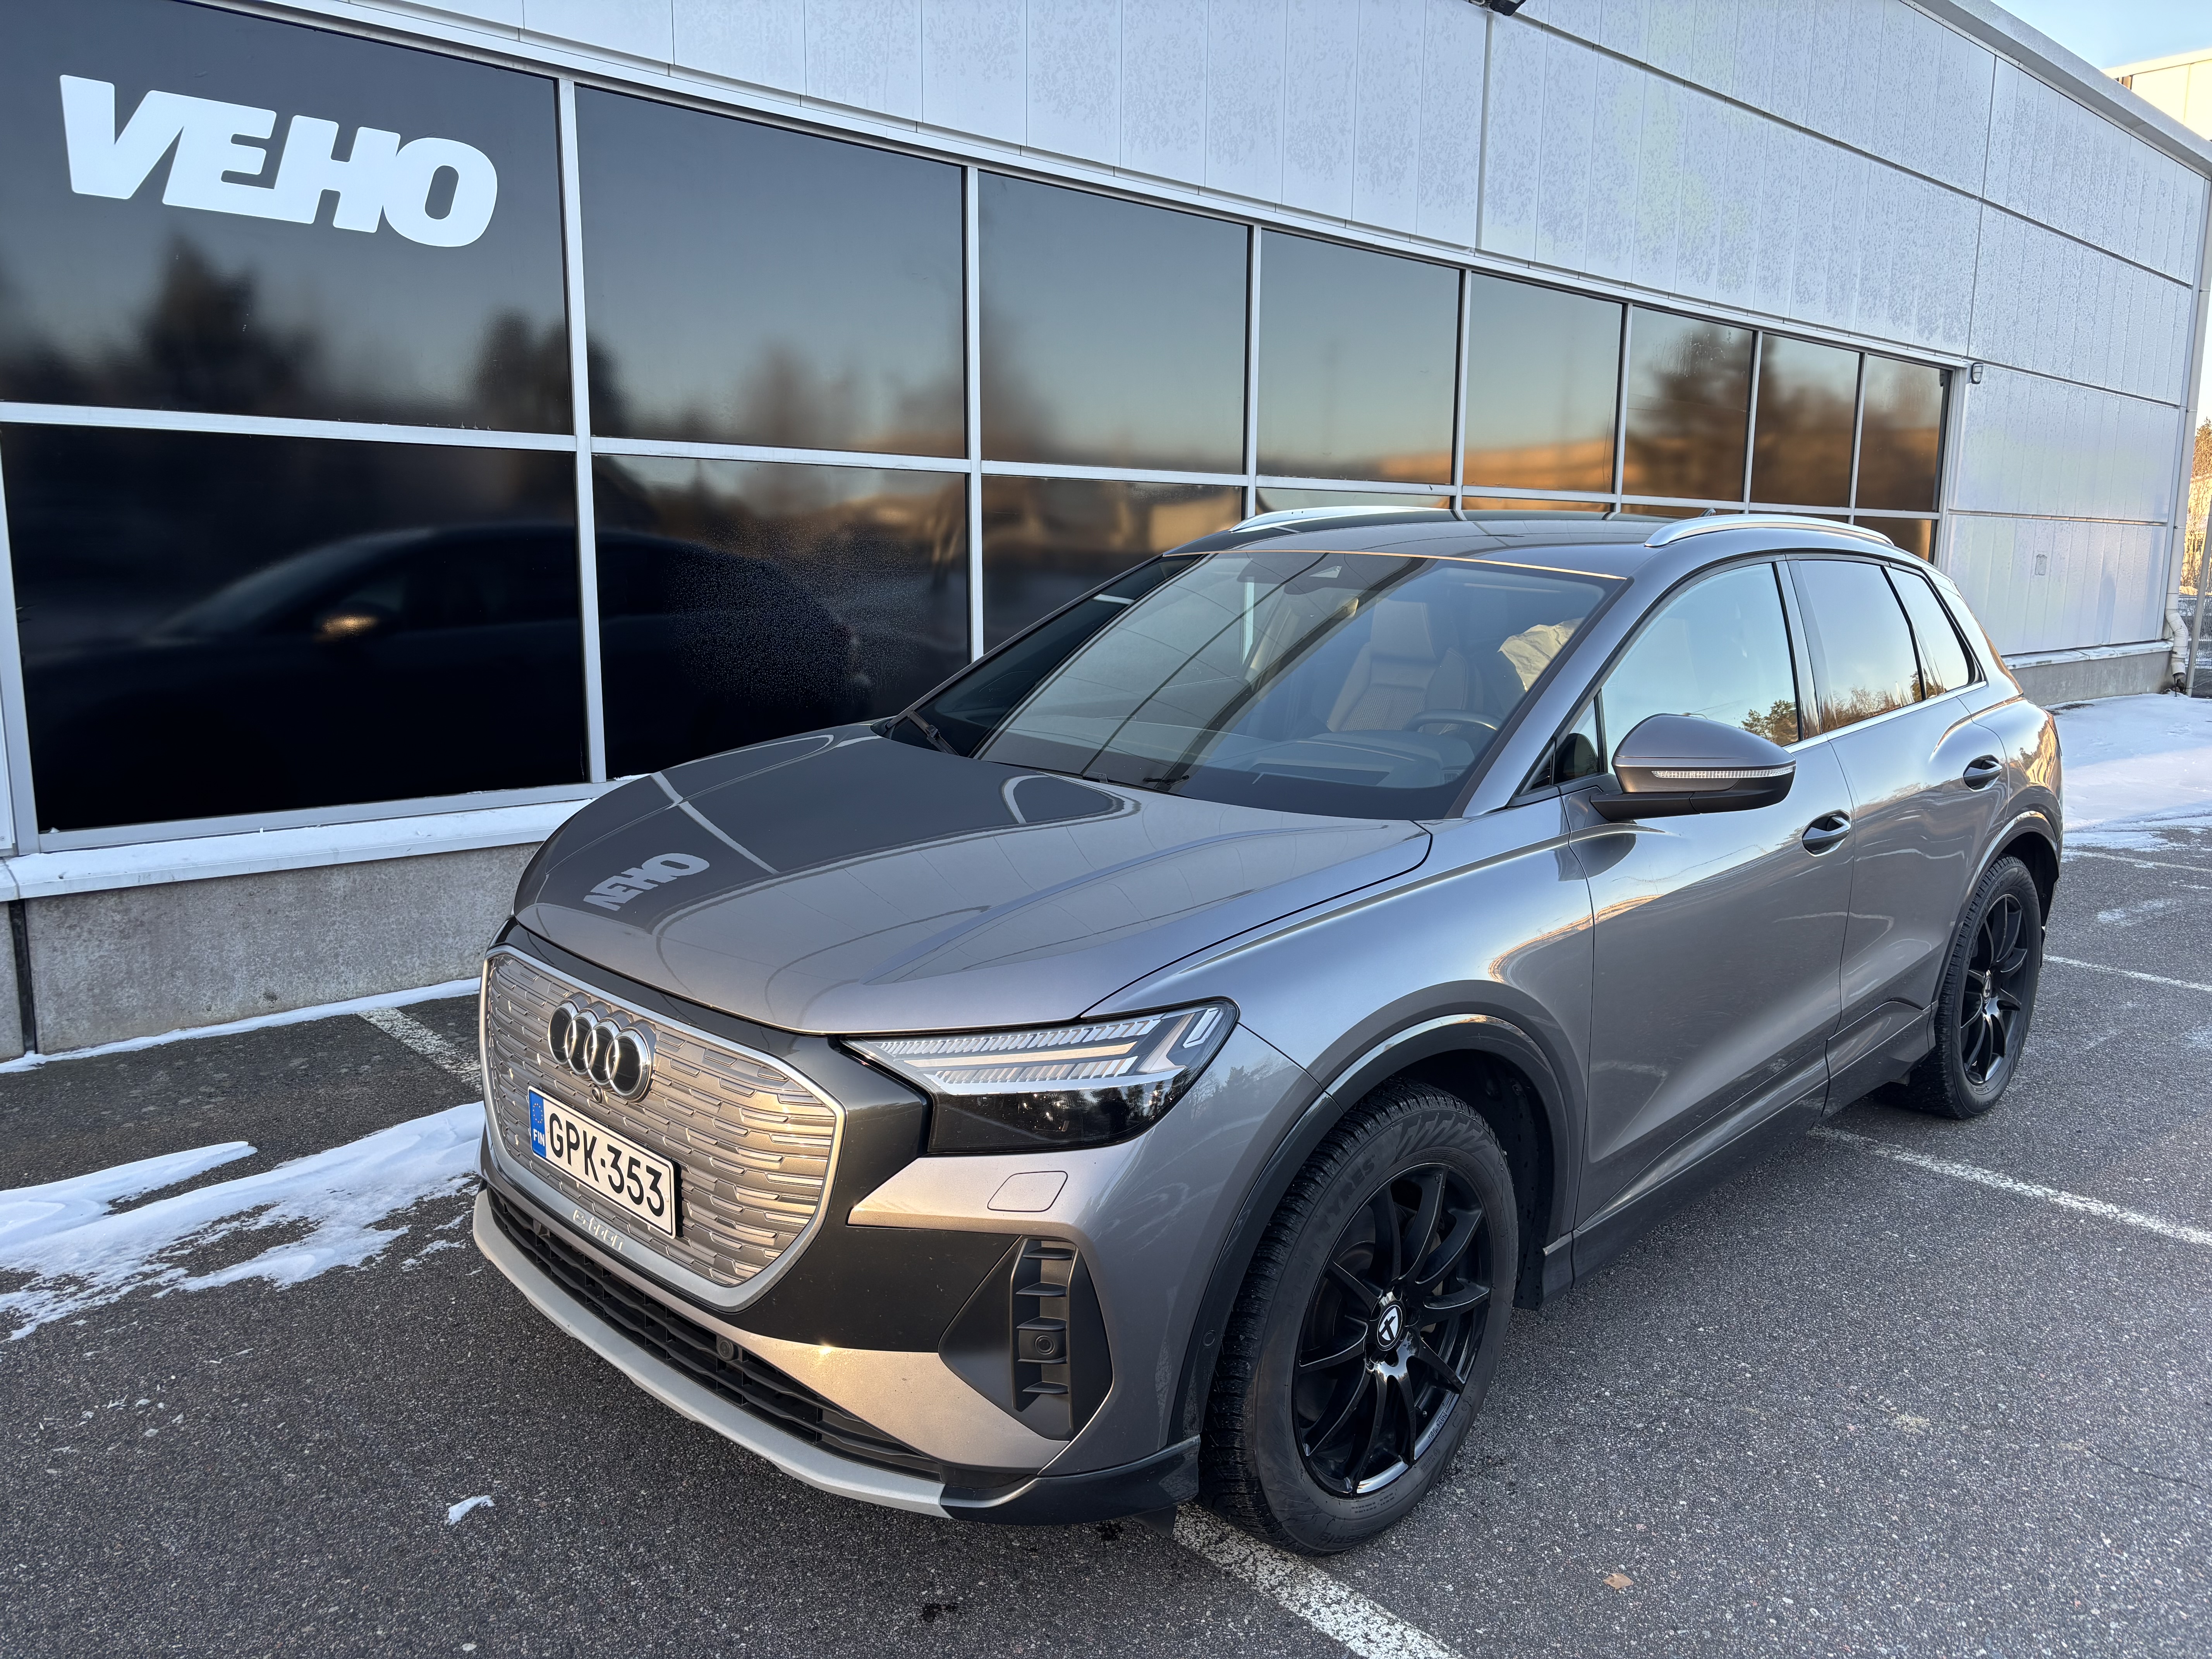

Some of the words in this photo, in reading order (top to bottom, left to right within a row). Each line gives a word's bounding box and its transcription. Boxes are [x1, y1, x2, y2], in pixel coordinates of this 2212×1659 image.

[60, 74, 498, 247] VEHO
[533, 1129, 545, 1147] FIN
[549, 1113, 665, 1217] GPK-353
